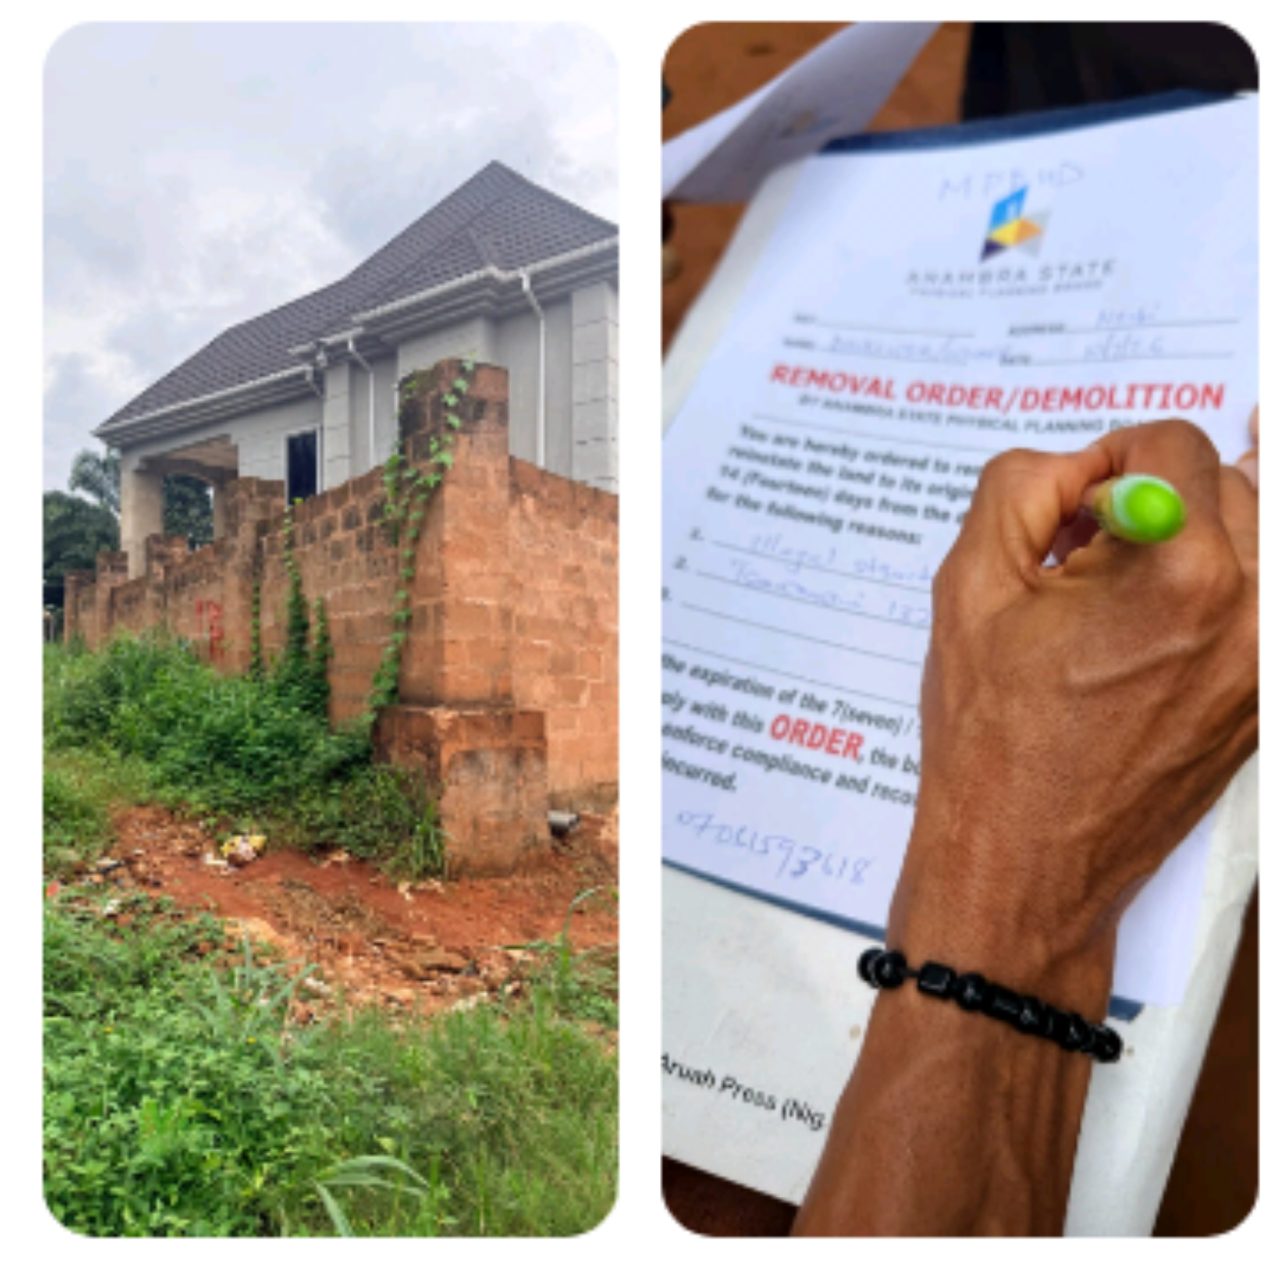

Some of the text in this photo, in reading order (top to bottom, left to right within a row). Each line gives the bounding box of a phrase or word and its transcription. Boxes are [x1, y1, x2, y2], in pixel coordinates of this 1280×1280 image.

[769, 362, 1226, 415] REMOVAL ORDER/DEMOLITION
[864, 450, 930, 471] ordered
[689, 665, 775, 700] expiration
[799, 694, 829, 714] the
[690, 701, 729, 722] with
[732, 710, 765, 734] this
[870, 747, 898, 770] the
[731, 745, 832, 784] compliance
[835, 773, 871, 795] and
[718, 1076, 777, 1111] Press
